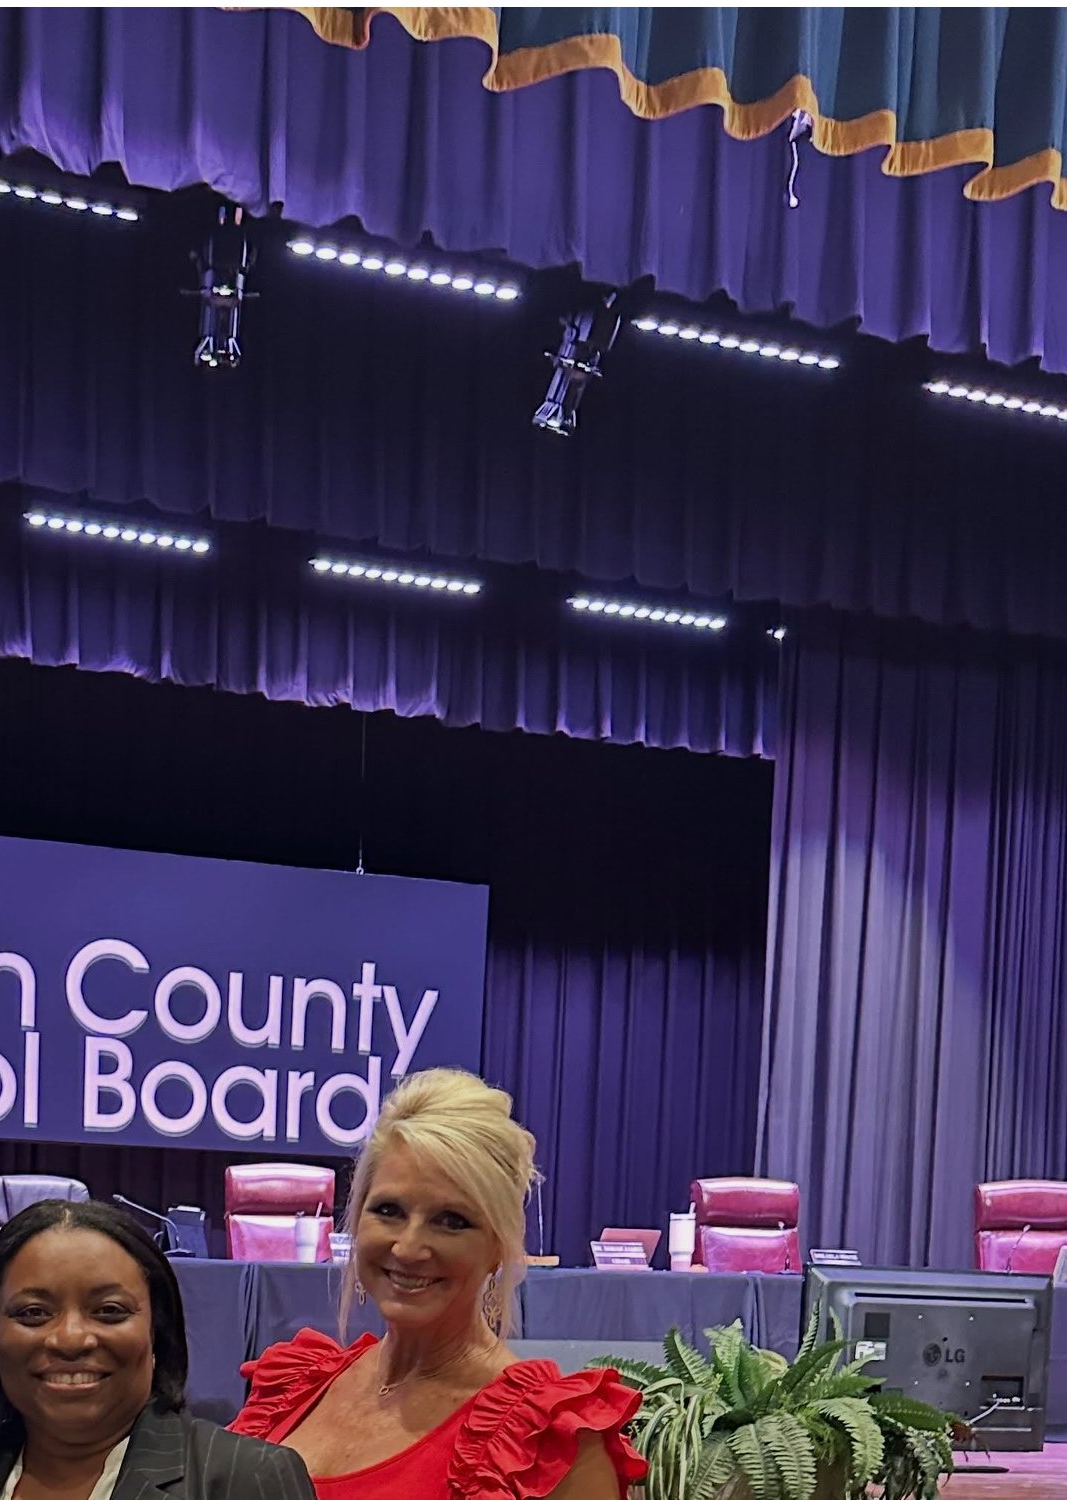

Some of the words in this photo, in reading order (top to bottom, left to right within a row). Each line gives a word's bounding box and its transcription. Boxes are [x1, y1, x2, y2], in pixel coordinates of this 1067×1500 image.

[65, 938, 439, 1080] County
[83, 1035, 382, 1148] Board
[945, 1348, 966, 1363] LG
